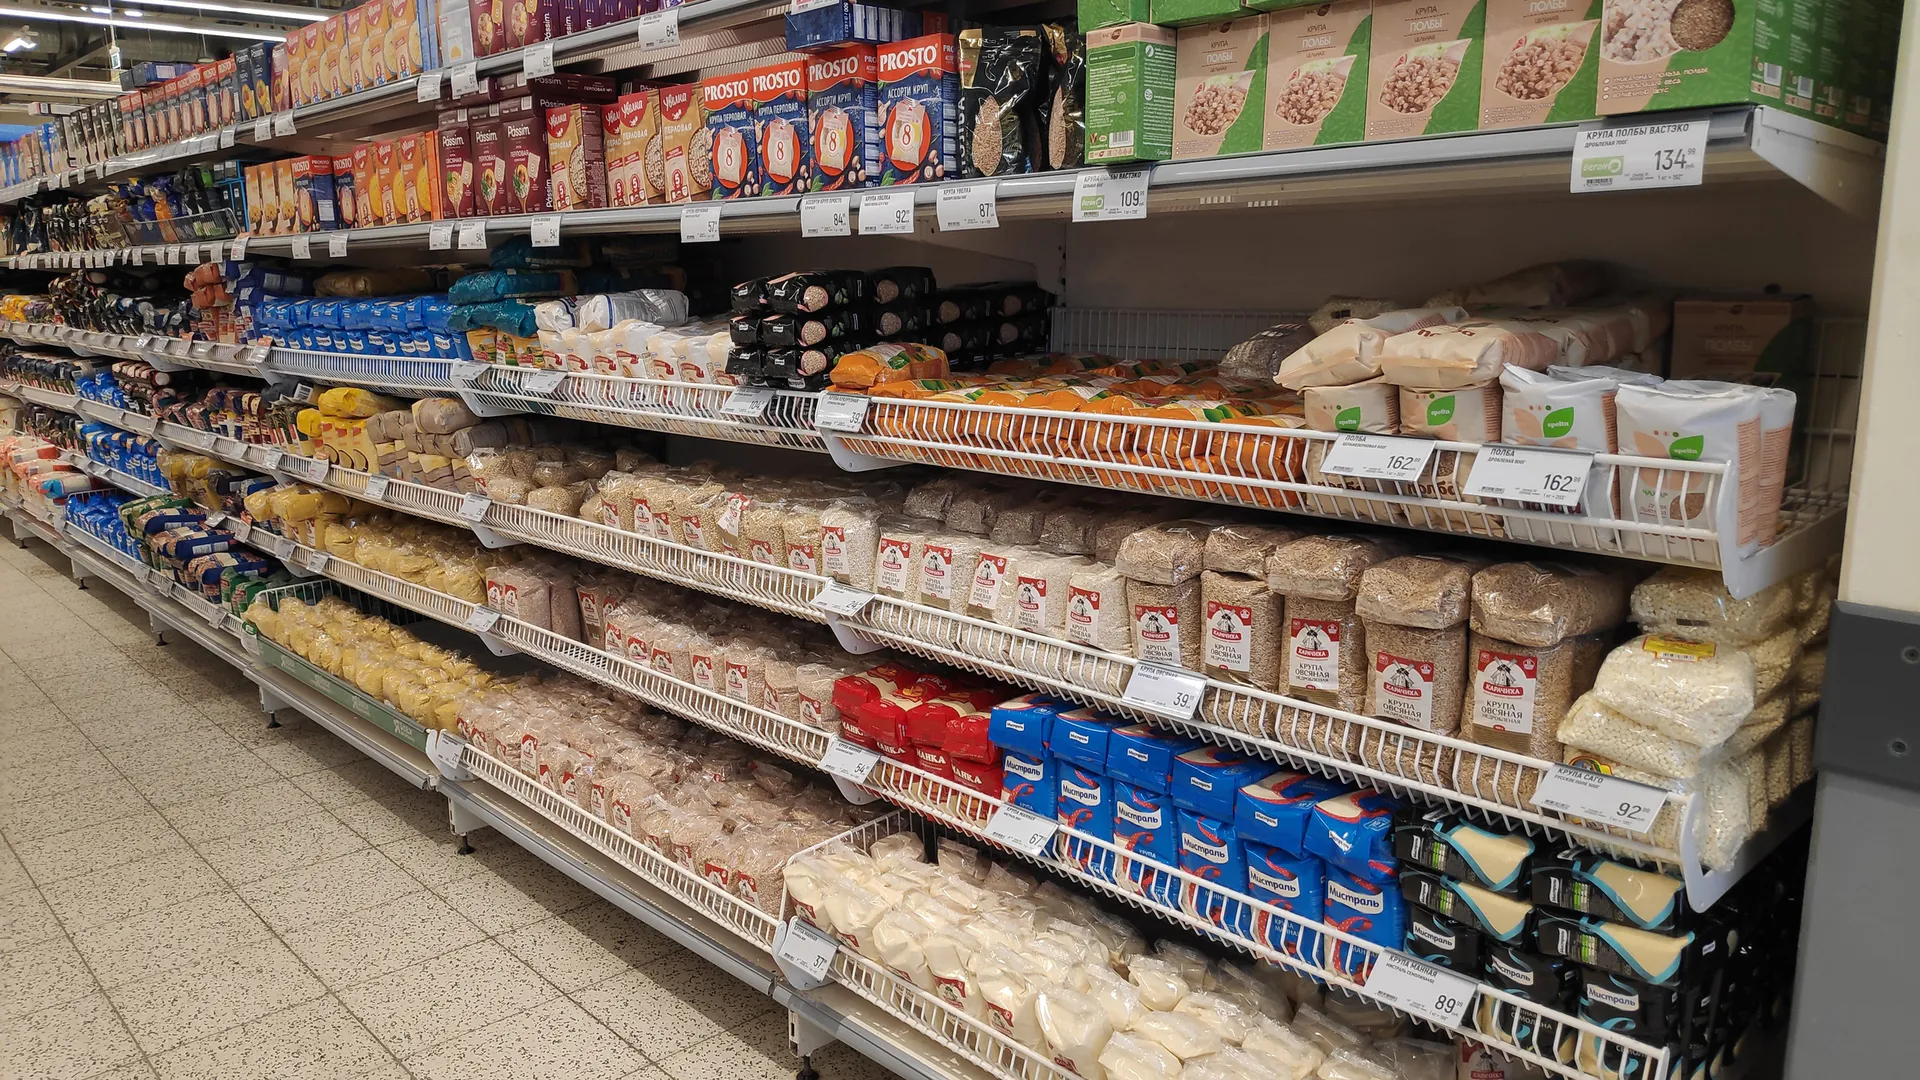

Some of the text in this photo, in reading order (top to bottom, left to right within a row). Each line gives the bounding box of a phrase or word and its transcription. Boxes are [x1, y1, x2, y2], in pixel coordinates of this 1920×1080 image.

[1415, 7, 1437, 16] КРУПА
[1307, 24, 1327, 33] КРУПА
[1410, 19, 1442, 32] ПОЛБЫ
[943, 45, 953, 53] PRO
[1210, 40, 1229, 48] КРУПА
[1302, 38, 1331, 48] ПОЛБЫ
[864, 56, 877, 64] PRO
[879, 45, 937, 73] PROSTO
[1206, 52, 1232, 63] ПОЛБЫ
[809, 56, 859, 82] PROSTO
[753, 67, 800, 93] PROSTO
[704, 80, 748, 101] PROSTO
[888, 84, 928, 98] АССОРТИ КРУП
[816, 92, 851, 107] АССОРТИ КРУП
[758, 102, 799, 116] КРУПА ПЕРЛОВАЯ
[709, 111, 747, 124] КРУПА ПЕРЛОВАЯ
[622, 130, 648, 140] ПЕРЛОВАЯ
[664, 124, 692, 134] ПЕРЛОВАЯ
[902, 124, 911, 145] 8
[1586, 124, 1689, 140] КРУПА ПОЛБЫ ВАСТЭКО
[829, 132, 837, 152] 8
[1584, 140, 1615, 148] ДРОБЛЕНАЯ
[725, 148, 733, 167] 8
[776, 141, 784, 160] 8
[1654, 148, 1696, 171] 134 99
[1120, 190, 1140, 207] 109
[895, 210, 906, 224] 92
[979, 203, 990, 218] 87
[833, 213, 843, 226] 84
[850, 412, 860, 424] 39
[1547, 420, 1570, 428] spelta
[1345, 434, 1366, 442] ПОЛБА
[1490, 448, 1516, 456] ПОЛБА
[1387, 456, 1414, 470] 162
[1487, 456, 1514, 464] ДРОБЛЕНАЯ
[1543, 474, 1573, 492] 162
[1143, 649, 1173, 658] ОВСЯНАЯ
[1210, 648, 1242, 660] ОВСЯНАЯ
[1214, 643, 1236, 653] КРУПА
[1140, 666, 1155, 674] КРУПА
[1295, 668, 1330, 678] ОВСЯНАЯ
[1300, 662, 1324, 671] КРУПА
[1385, 684, 1419, 696] КАРАЧИХА
[1485, 684, 1521, 695] КАРАЧИХА
[1173, 692, 1190, 708] 39
[1388, 698, 1416, 710] КРУПА
[1486, 700, 1516, 711] КРУПА
[1383, 704, 1422, 718] ОВСЯНАЯ
[1481, 706, 1523, 719] ОВСЯНАЯ
[1482, 714, 1521, 724] НЕДРОБЛЕНАЯ
[916, 747, 947, 764] МАНКА
[854, 763, 866, 774] 54
[1006, 760, 1041, 776] Мистраль
[1558, 768, 1604, 784] КРУПА САГО
[1062, 784, 1098, 801] Мистраль
[1118, 805, 1159, 824] Мистраль
[1616, 802, 1651, 820] 92 99
[1028, 834, 1044, 845] 67
[1184, 837, 1226, 860] Мистраль
[1250, 870, 1297, 893] Мистраль
[1328, 884, 1380, 909] Мистраль
[1414, 925, 1453, 946] Мистраль
[813, 954, 825, 969] 37
[1386, 963, 1406, 974] МИСТРАЛЬ
[1388, 955, 1438, 978] КРУПА МАННАЯ
[1435, 994, 1464, 1014] 89 99
[1588, 988, 1636, 1007] Мистраль
[1510, 1012, 1552, 1030] СМОЛНА
